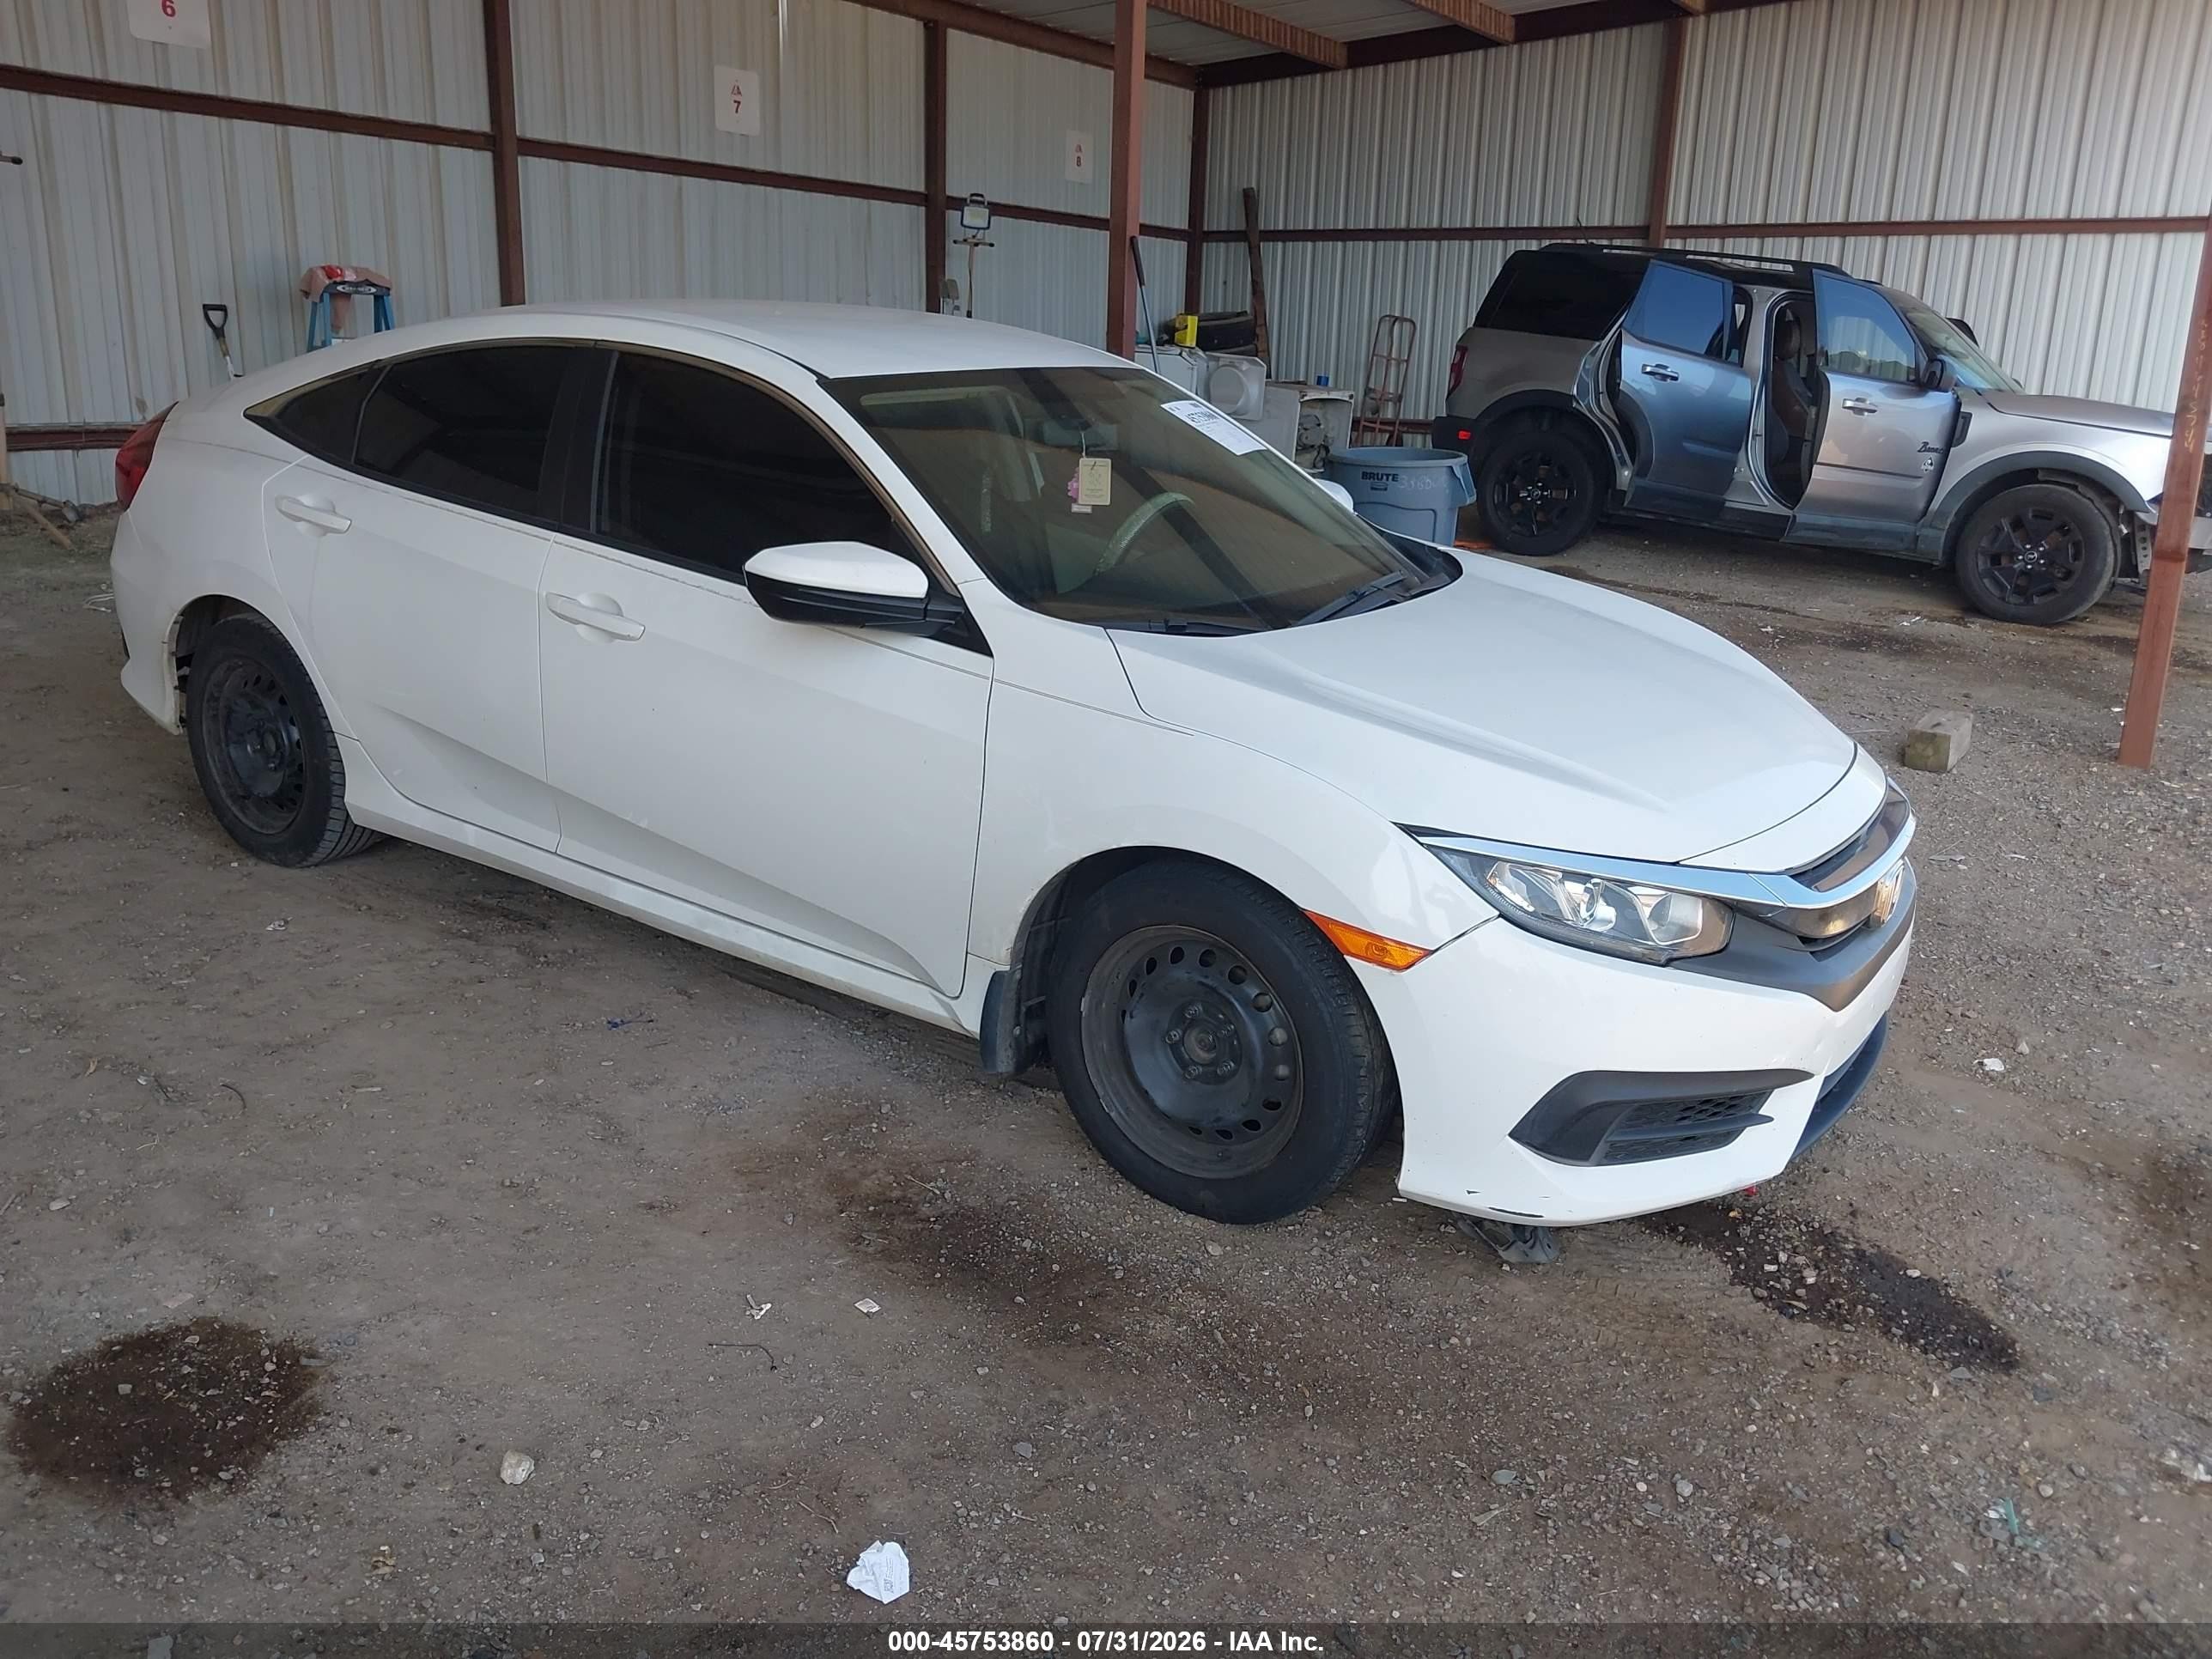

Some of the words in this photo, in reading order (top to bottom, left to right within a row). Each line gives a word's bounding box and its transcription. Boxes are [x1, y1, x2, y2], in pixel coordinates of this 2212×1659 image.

[161, 0, 176, 17] 6
[733, 100, 741, 114] 7
[1076, 155, 1082, 167] 8
[1361, 471, 1400, 482] BRUTE
